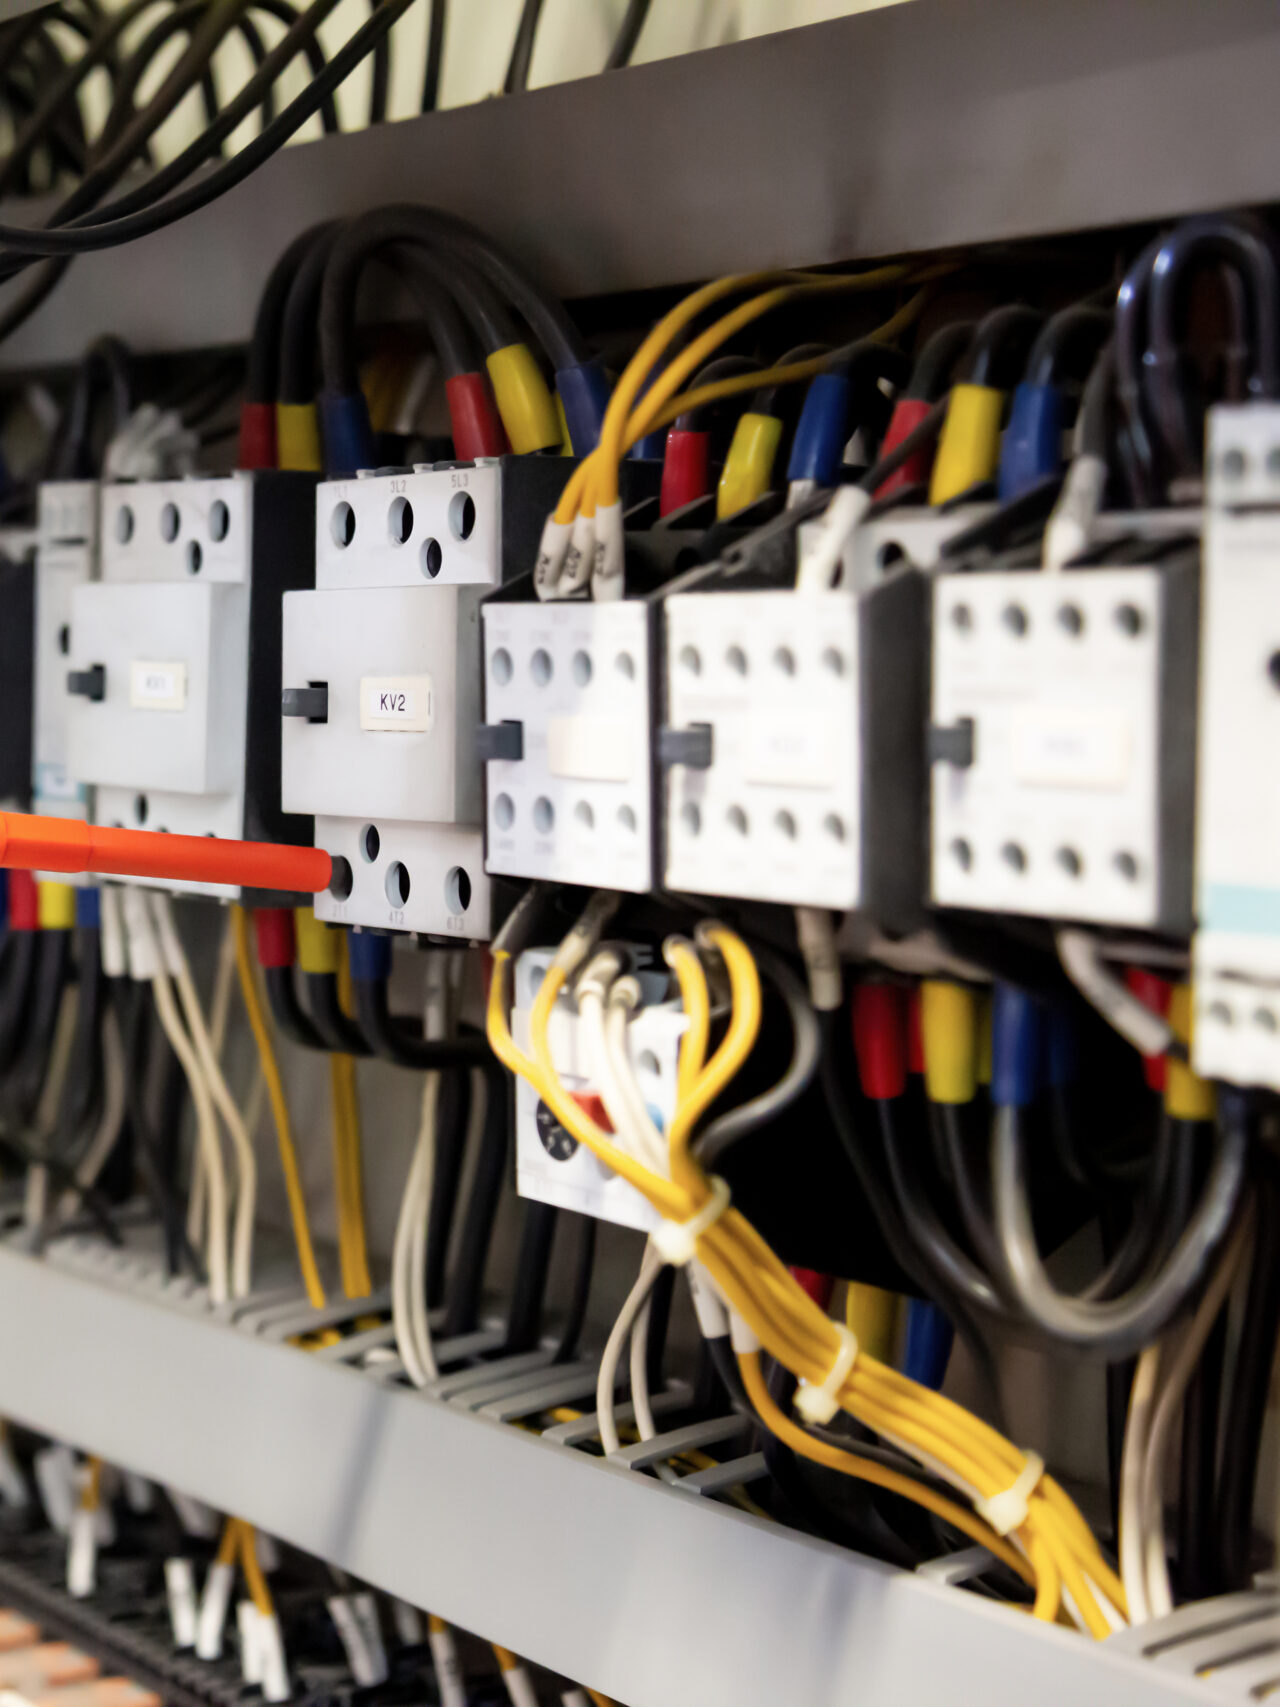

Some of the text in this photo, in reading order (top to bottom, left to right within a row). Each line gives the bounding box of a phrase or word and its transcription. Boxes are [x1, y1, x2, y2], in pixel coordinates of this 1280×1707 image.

[390, 480, 406, 493] 3L2
[452, 474, 468, 488] 5L3
[381, 693, 406, 712] KV2
[389, 911, 404, 925] 4T2
